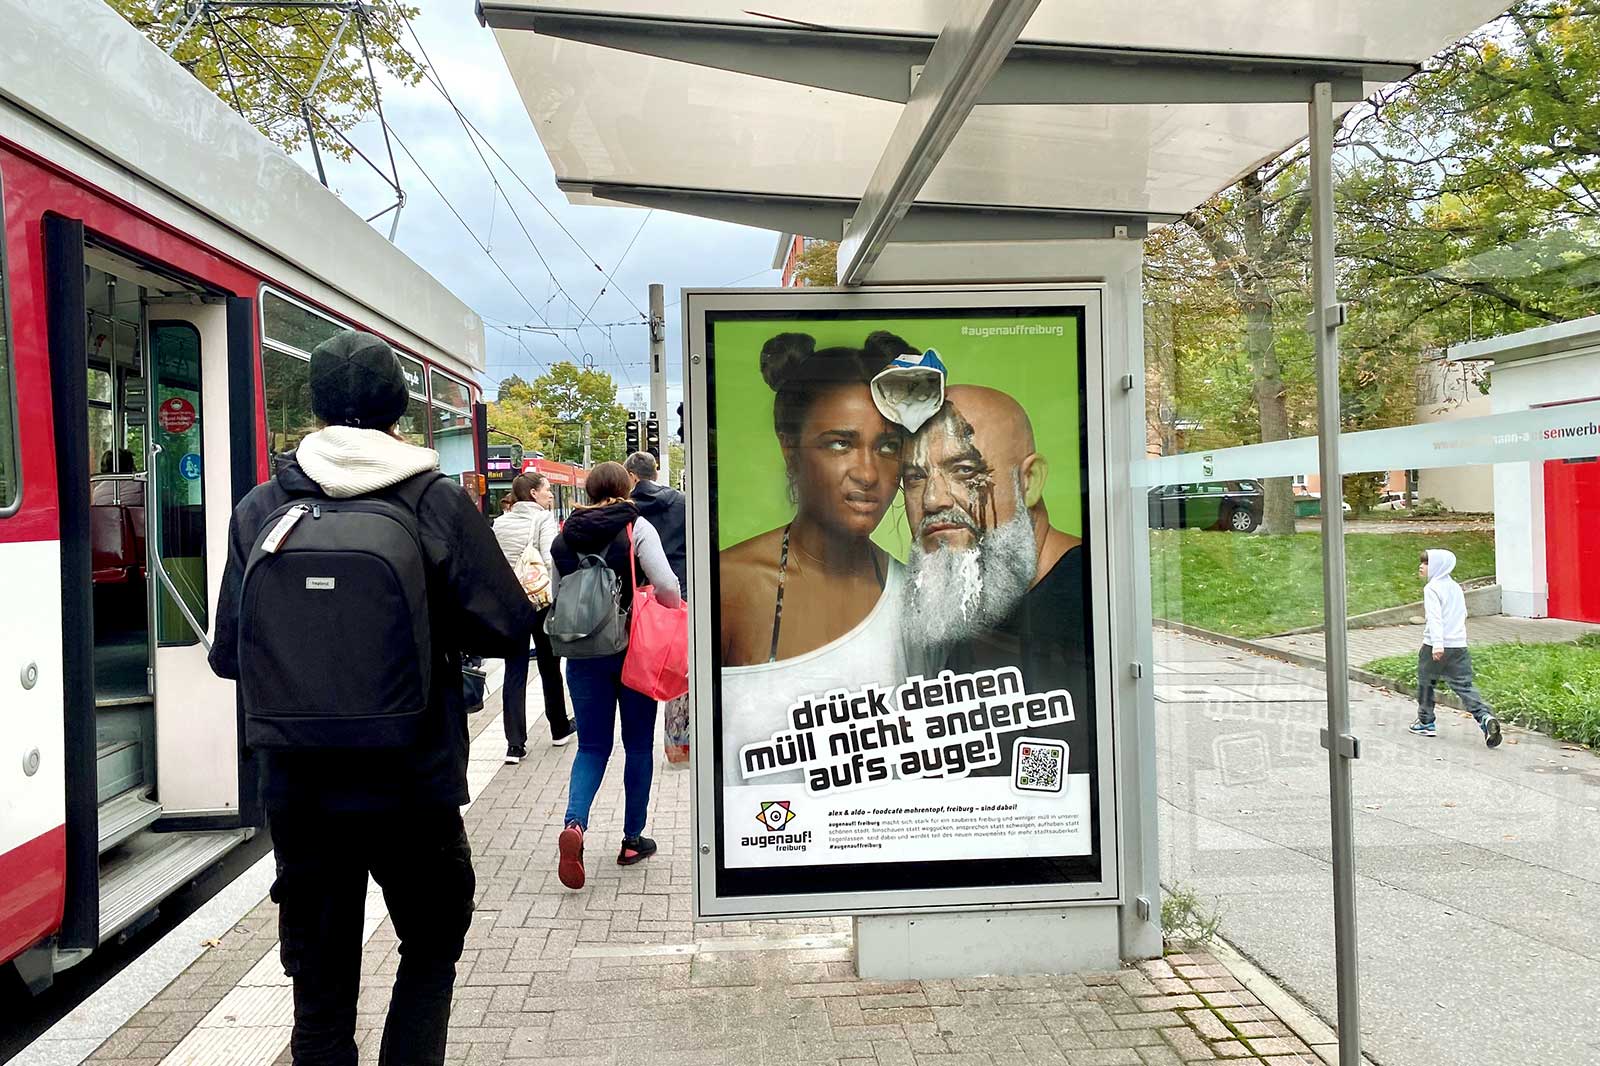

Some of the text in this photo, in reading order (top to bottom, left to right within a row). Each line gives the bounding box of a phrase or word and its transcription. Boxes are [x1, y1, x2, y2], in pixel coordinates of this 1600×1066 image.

[960, 324, 1064, 338] #augenauffreiburg
[792, 671, 1020, 730] drück deinen
[745, 694, 1070, 772] müll nicht anderen
[809, 732, 997, 792] aufs auge!
[946, 805, 974, 813] freiburg
[741, 830, 812, 848] augenauf!
